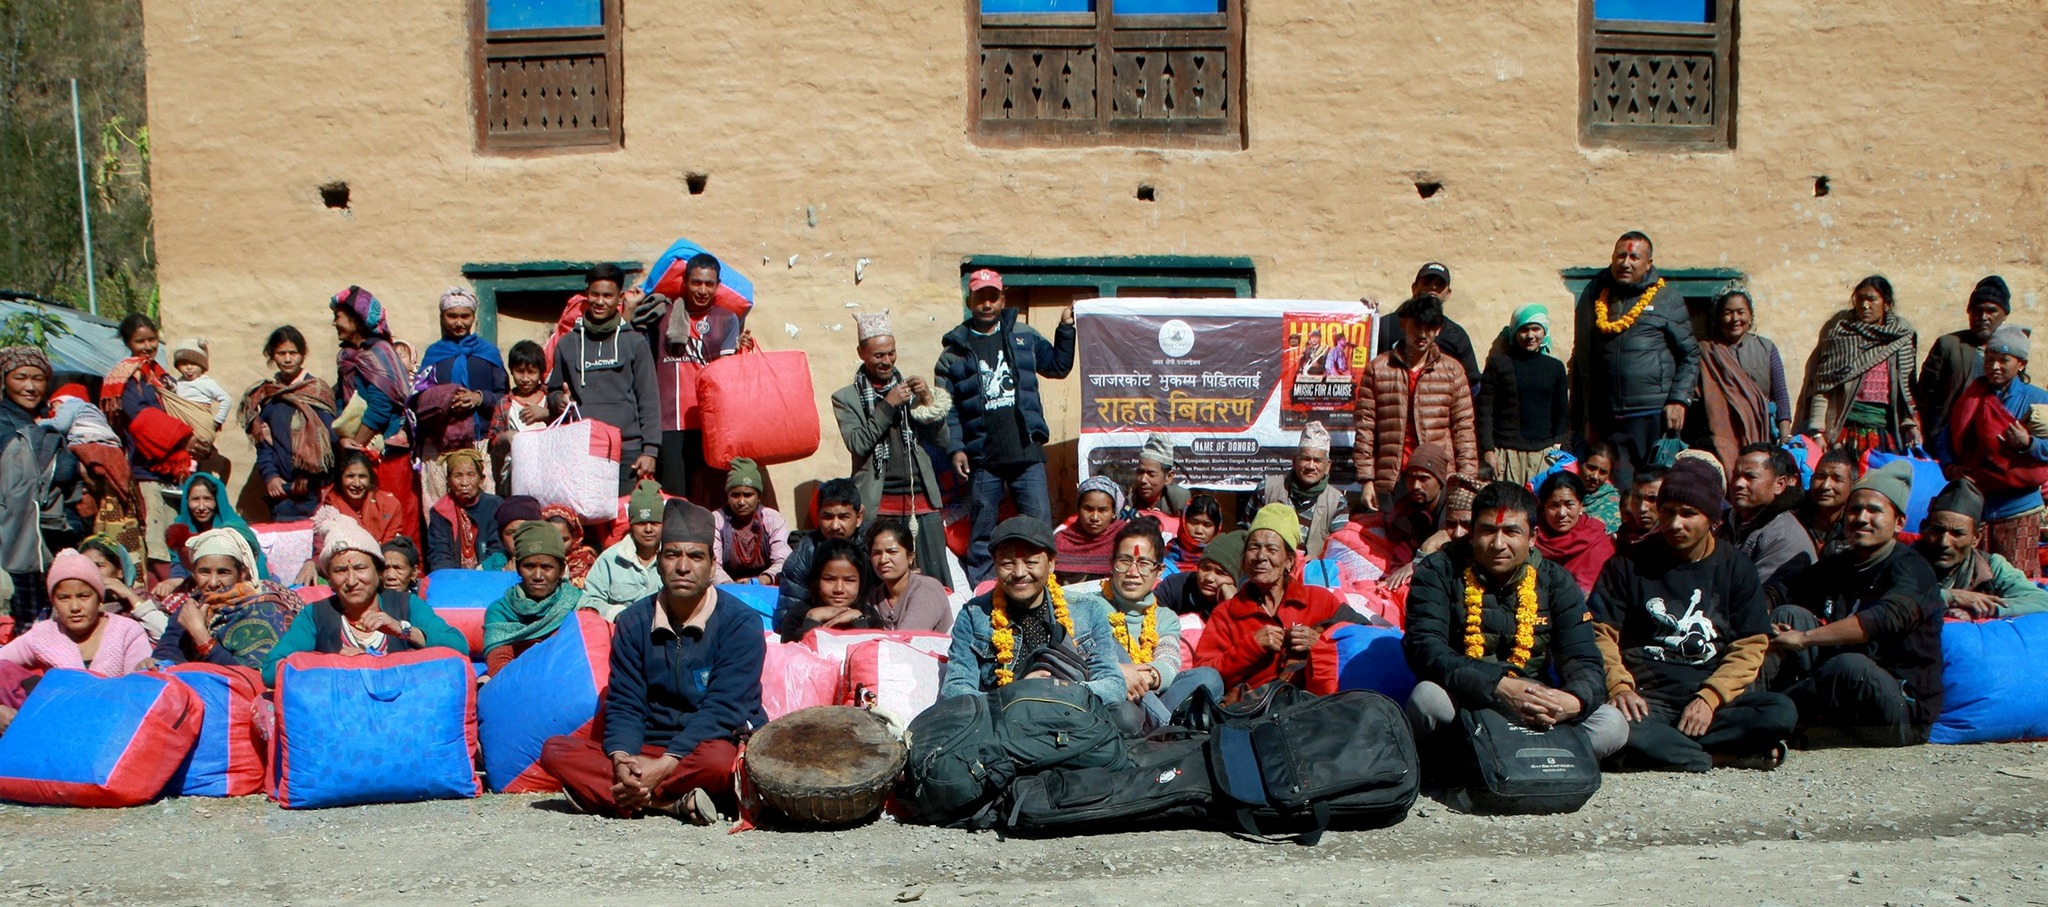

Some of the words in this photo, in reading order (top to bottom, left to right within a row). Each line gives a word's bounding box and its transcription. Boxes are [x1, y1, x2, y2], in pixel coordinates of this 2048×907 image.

[1089, 370, 1152, 388] जाजरकोट
[1159, 374, 1197, 391] भुकम्प
[1202, 371, 1262, 389] पिडितलाई
[1293, 383, 1314, 397] MUSIC
[1314, 383, 1327, 397] FOR
[1327, 383, 1332, 397] A
[1332, 383, 1353, 397] CAUSE
[1094, 397, 1158, 425] राहत
[1168, 390, 1254, 424] बितरण
[1194, 441, 1214, 452] NAME
[1216, 441, 1226, 452] OF
[1228, 441, 1256, 452] DONORS
